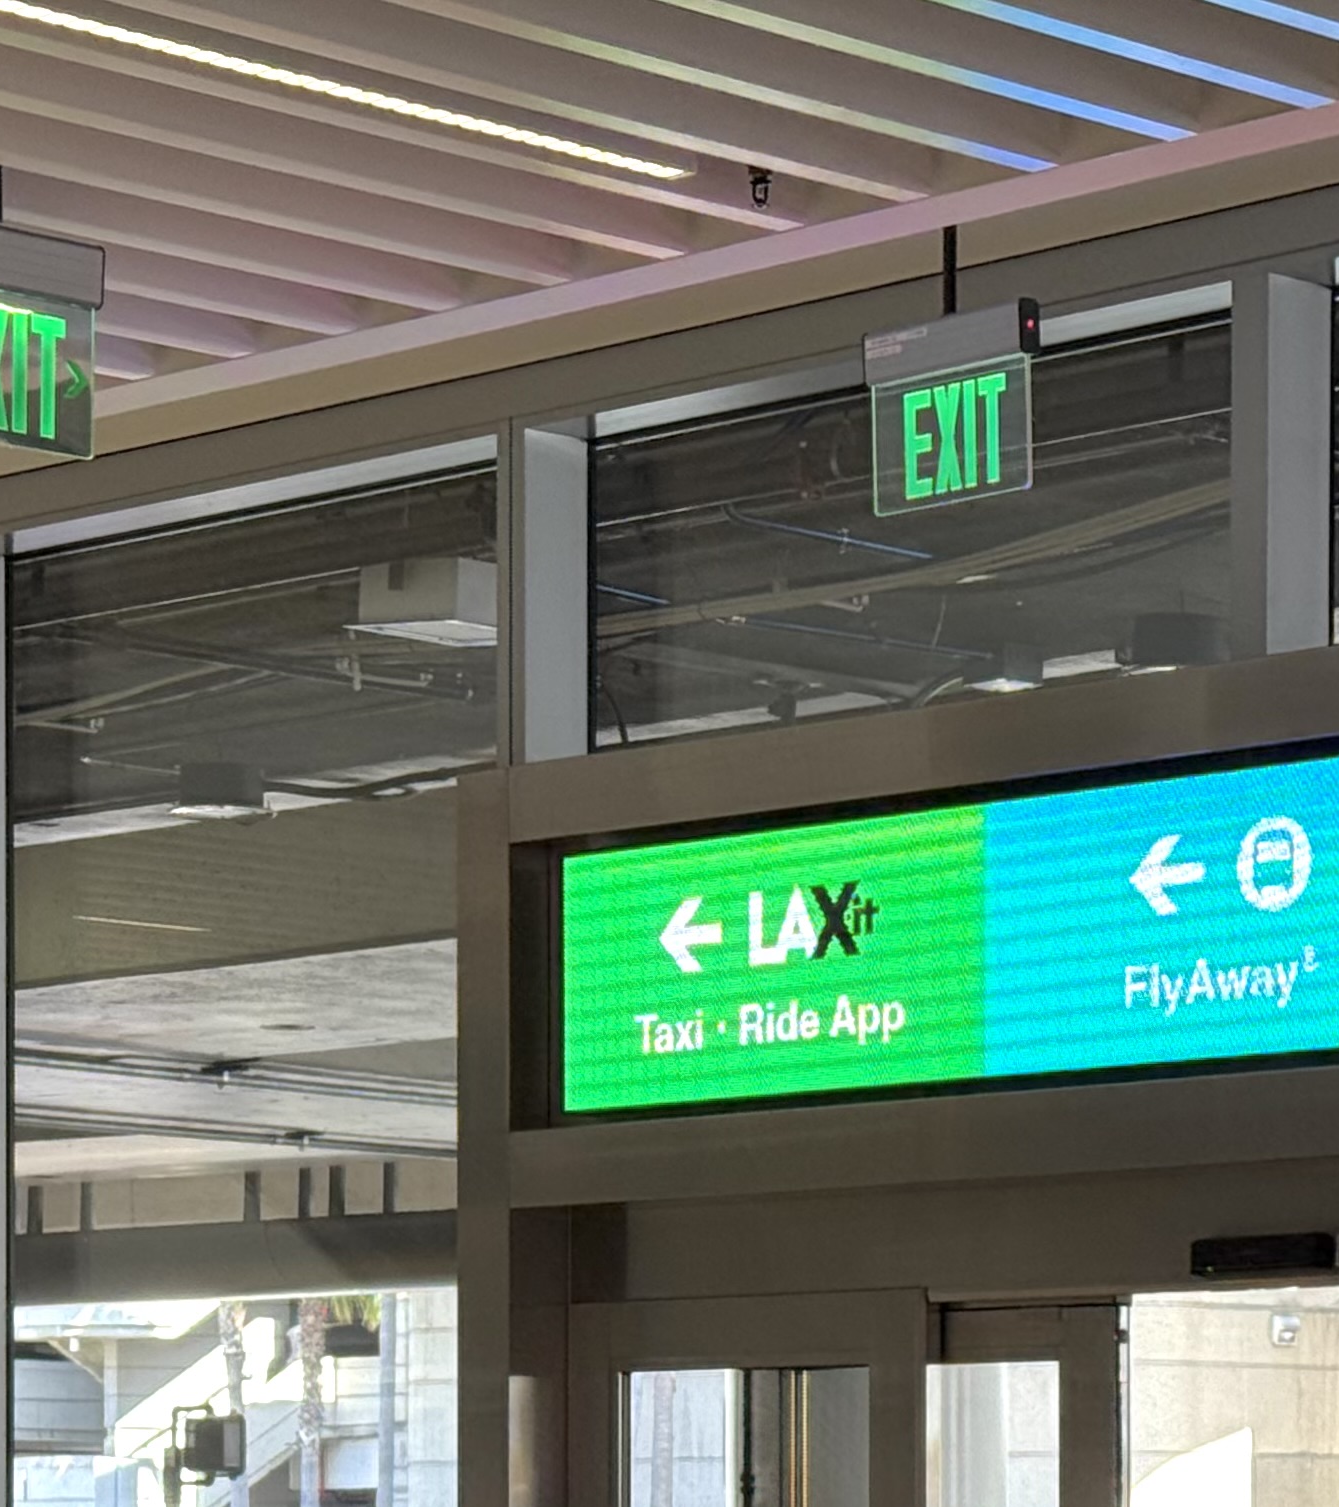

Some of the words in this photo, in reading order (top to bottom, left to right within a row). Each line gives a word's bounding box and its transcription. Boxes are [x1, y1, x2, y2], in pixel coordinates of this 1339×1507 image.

[903, 372, 1006, 500] EXIT
[634, 1009, 704, 1054] Taxi
[739, 1000, 820, 1046] Ride
[829, 994, 906, 1046] App
